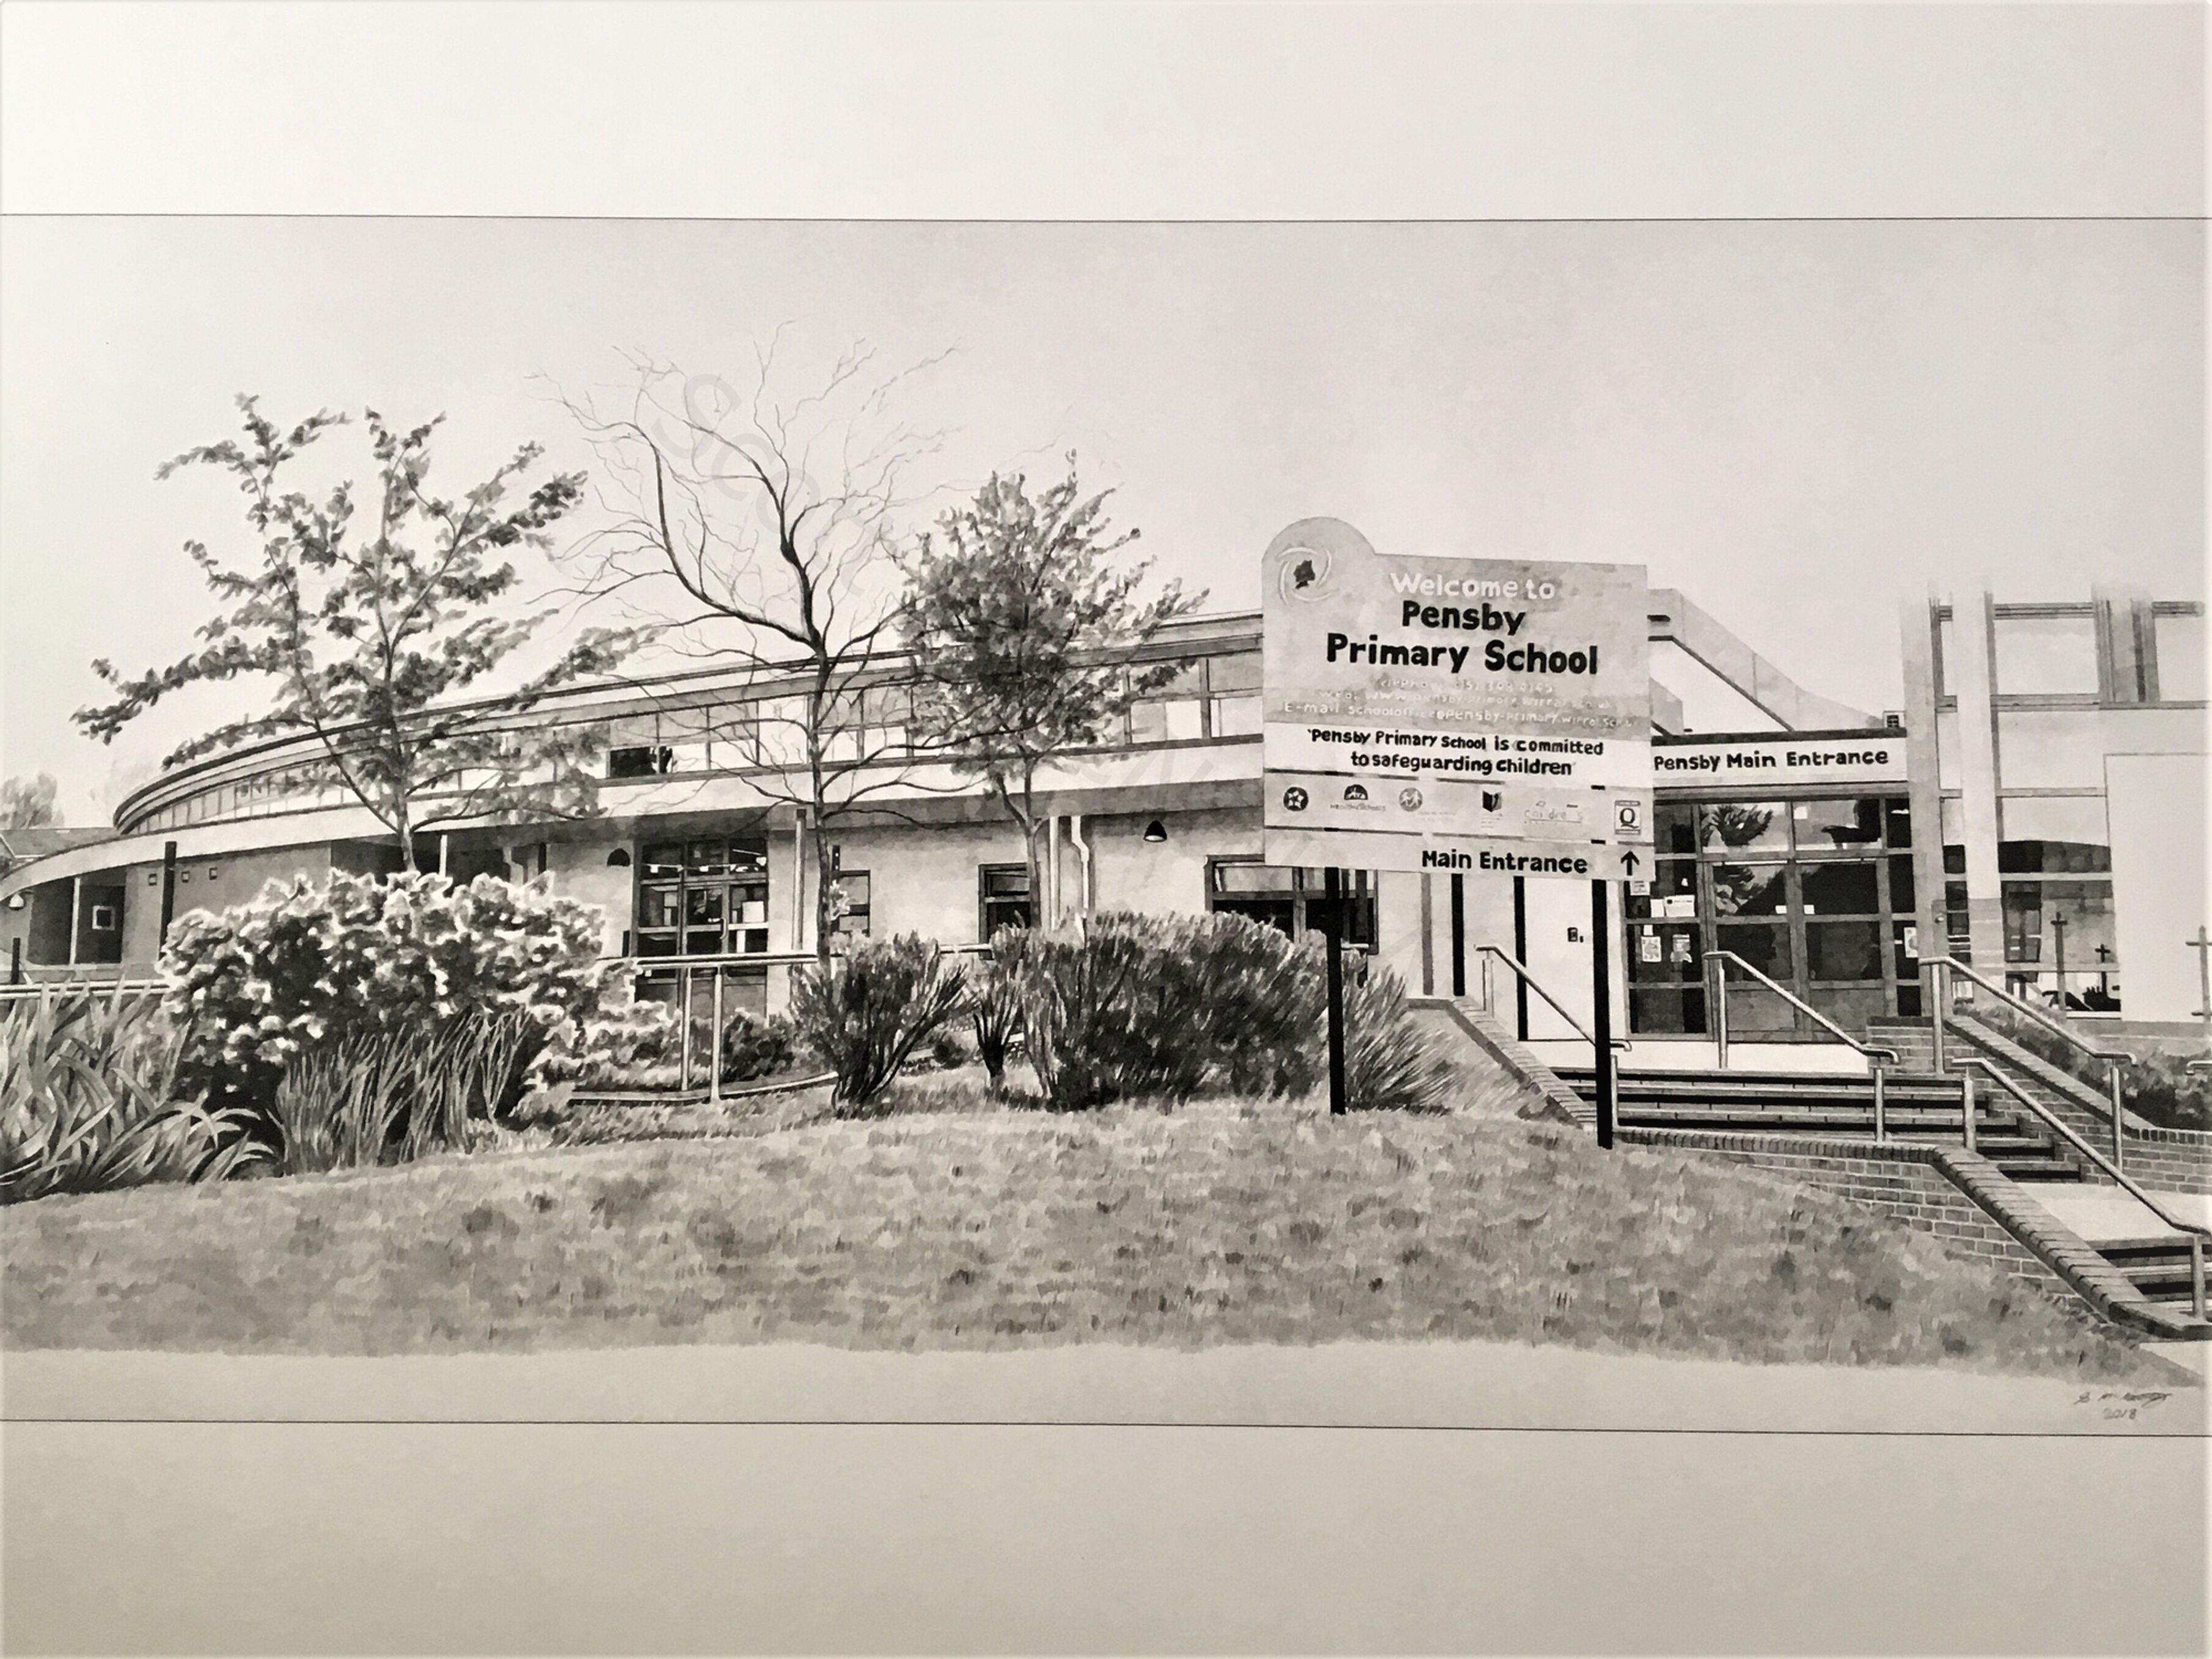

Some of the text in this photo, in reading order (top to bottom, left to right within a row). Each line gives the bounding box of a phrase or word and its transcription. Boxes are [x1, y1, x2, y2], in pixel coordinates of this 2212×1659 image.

[1390, 572, 1556, 599] Welcome to
[1403, 600, 1526, 635] Pensby
[1326, 632, 1597, 674] Primary School
[1376, 730, 1437, 746] Primary
[1442, 736, 1486, 749] School
[1495, 736, 1509, 750] is
[1517, 739, 1603, 755] committed
[1351, 752, 1369, 766] to
[1372, 754, 1492, 775] safeguarding
[1655, 751, 1888, 772] Pensby Main Entrance
[1620, 807, 1640, 829] Q
[1423, 849, 1587, 873] Main Entrance
